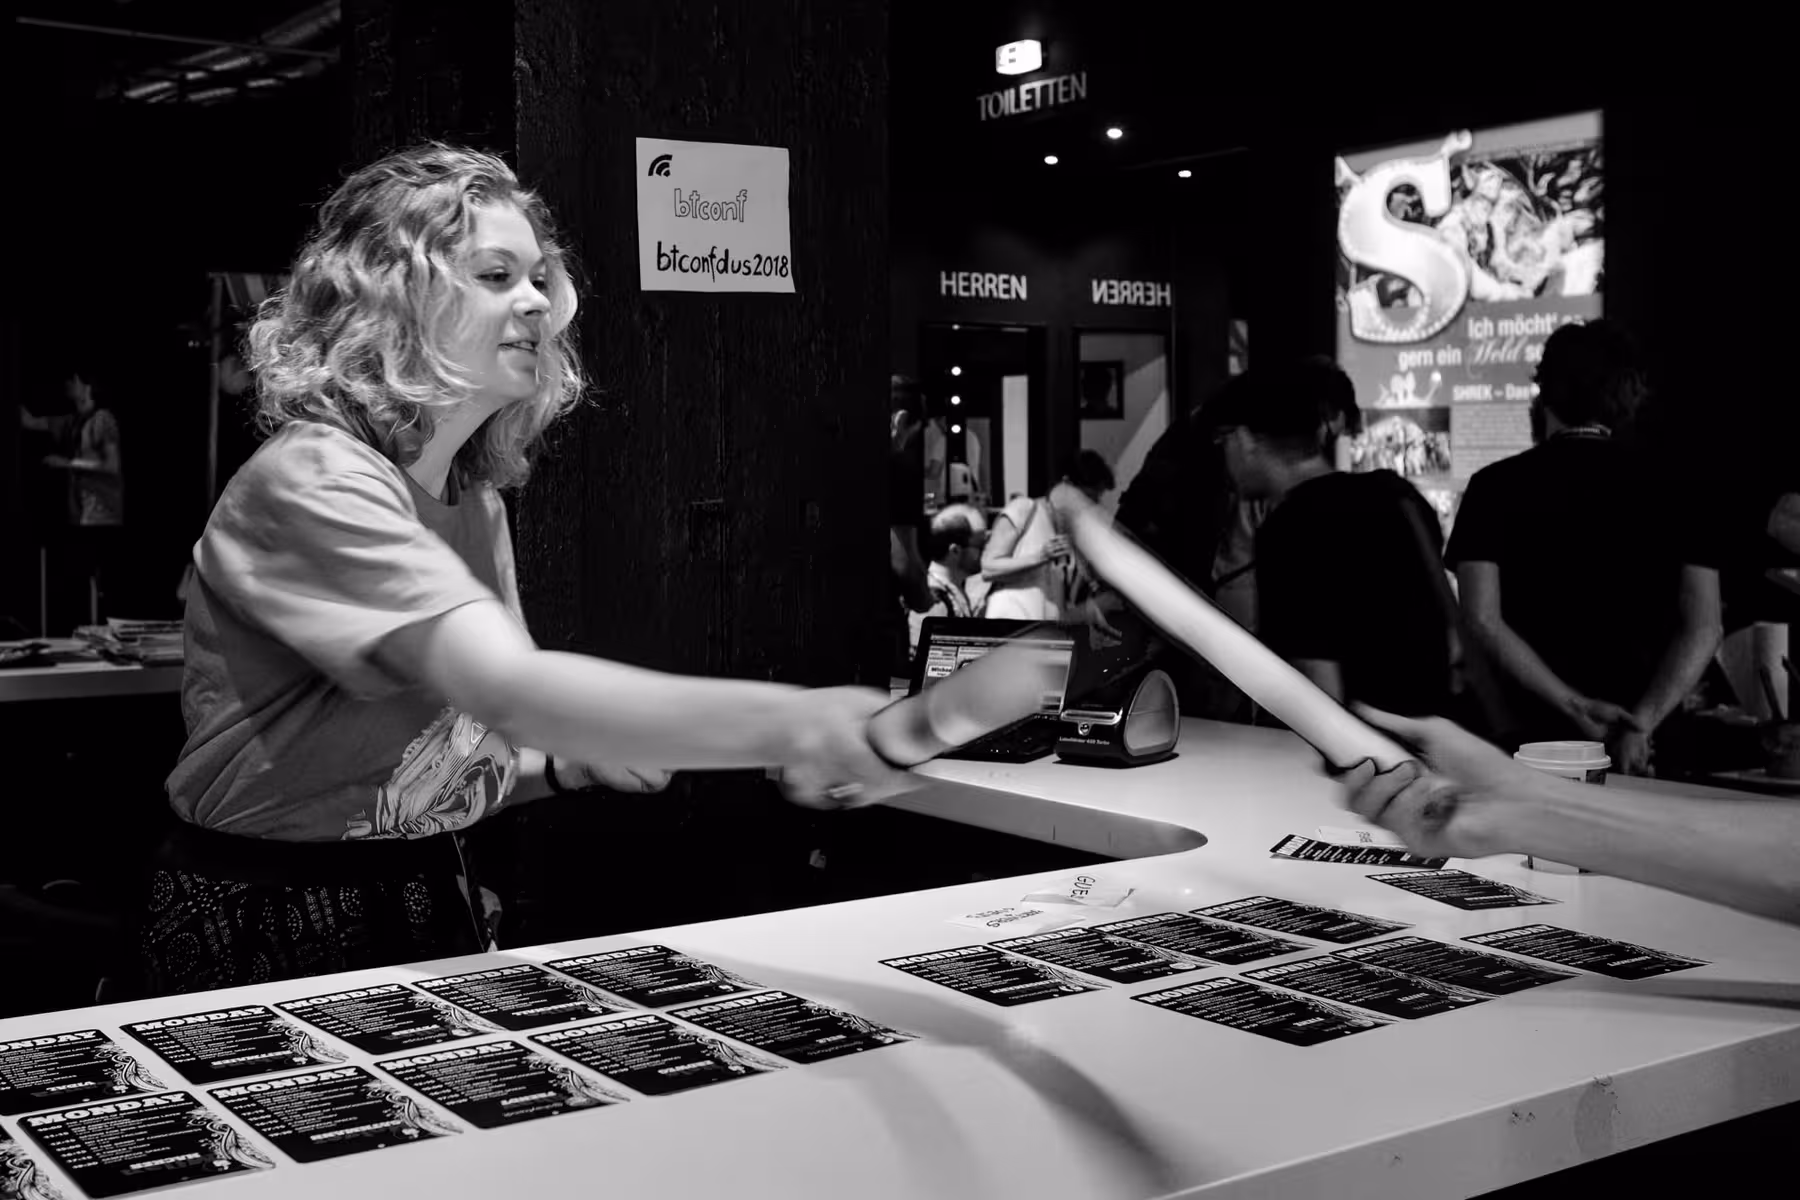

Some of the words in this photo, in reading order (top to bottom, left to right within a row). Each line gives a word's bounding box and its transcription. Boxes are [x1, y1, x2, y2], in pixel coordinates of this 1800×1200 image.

[977, 71, 1088, 121] TOILETTEN
[673, 188, 748, 223] btconf
[656, 241, 790, 283] btconfdus2018
[940, 271, 1028, 301] HERREN
[1468, 317, 1494, 339] Ich
[1398, 350, 1434, 372] gern
[1436, 344, 1462, 366] ein
[1094, 912, 1184, 932] MONDAY
[1467, 924, 1555, 943] MONDAY
[997, 928, 1090, 949] MONDAY
[1340, 937, 1424, 959] MONDAY
[550, 946, 659, 969] MONDAY
[884, 946, 989, 967] MONDAY
[1246, 956, 1341, 980] MONDAY
[418, 965, 534, 989] MONDAY
[1139, 977, 1238, 1003] MONDAY
[281, 984, 402, 1010] MONDAY
[672, 991, 788, 1019] MONDAY
[133, 1007, 266, 1032] MONDAY
[536, 1015, 660, 1044] MONDAY
[381, 1041, 515, 1071] MONDAY
[215, 1067, 360, 1100] MONDAY
[27, 1092, 185, 1126] MONDAY
